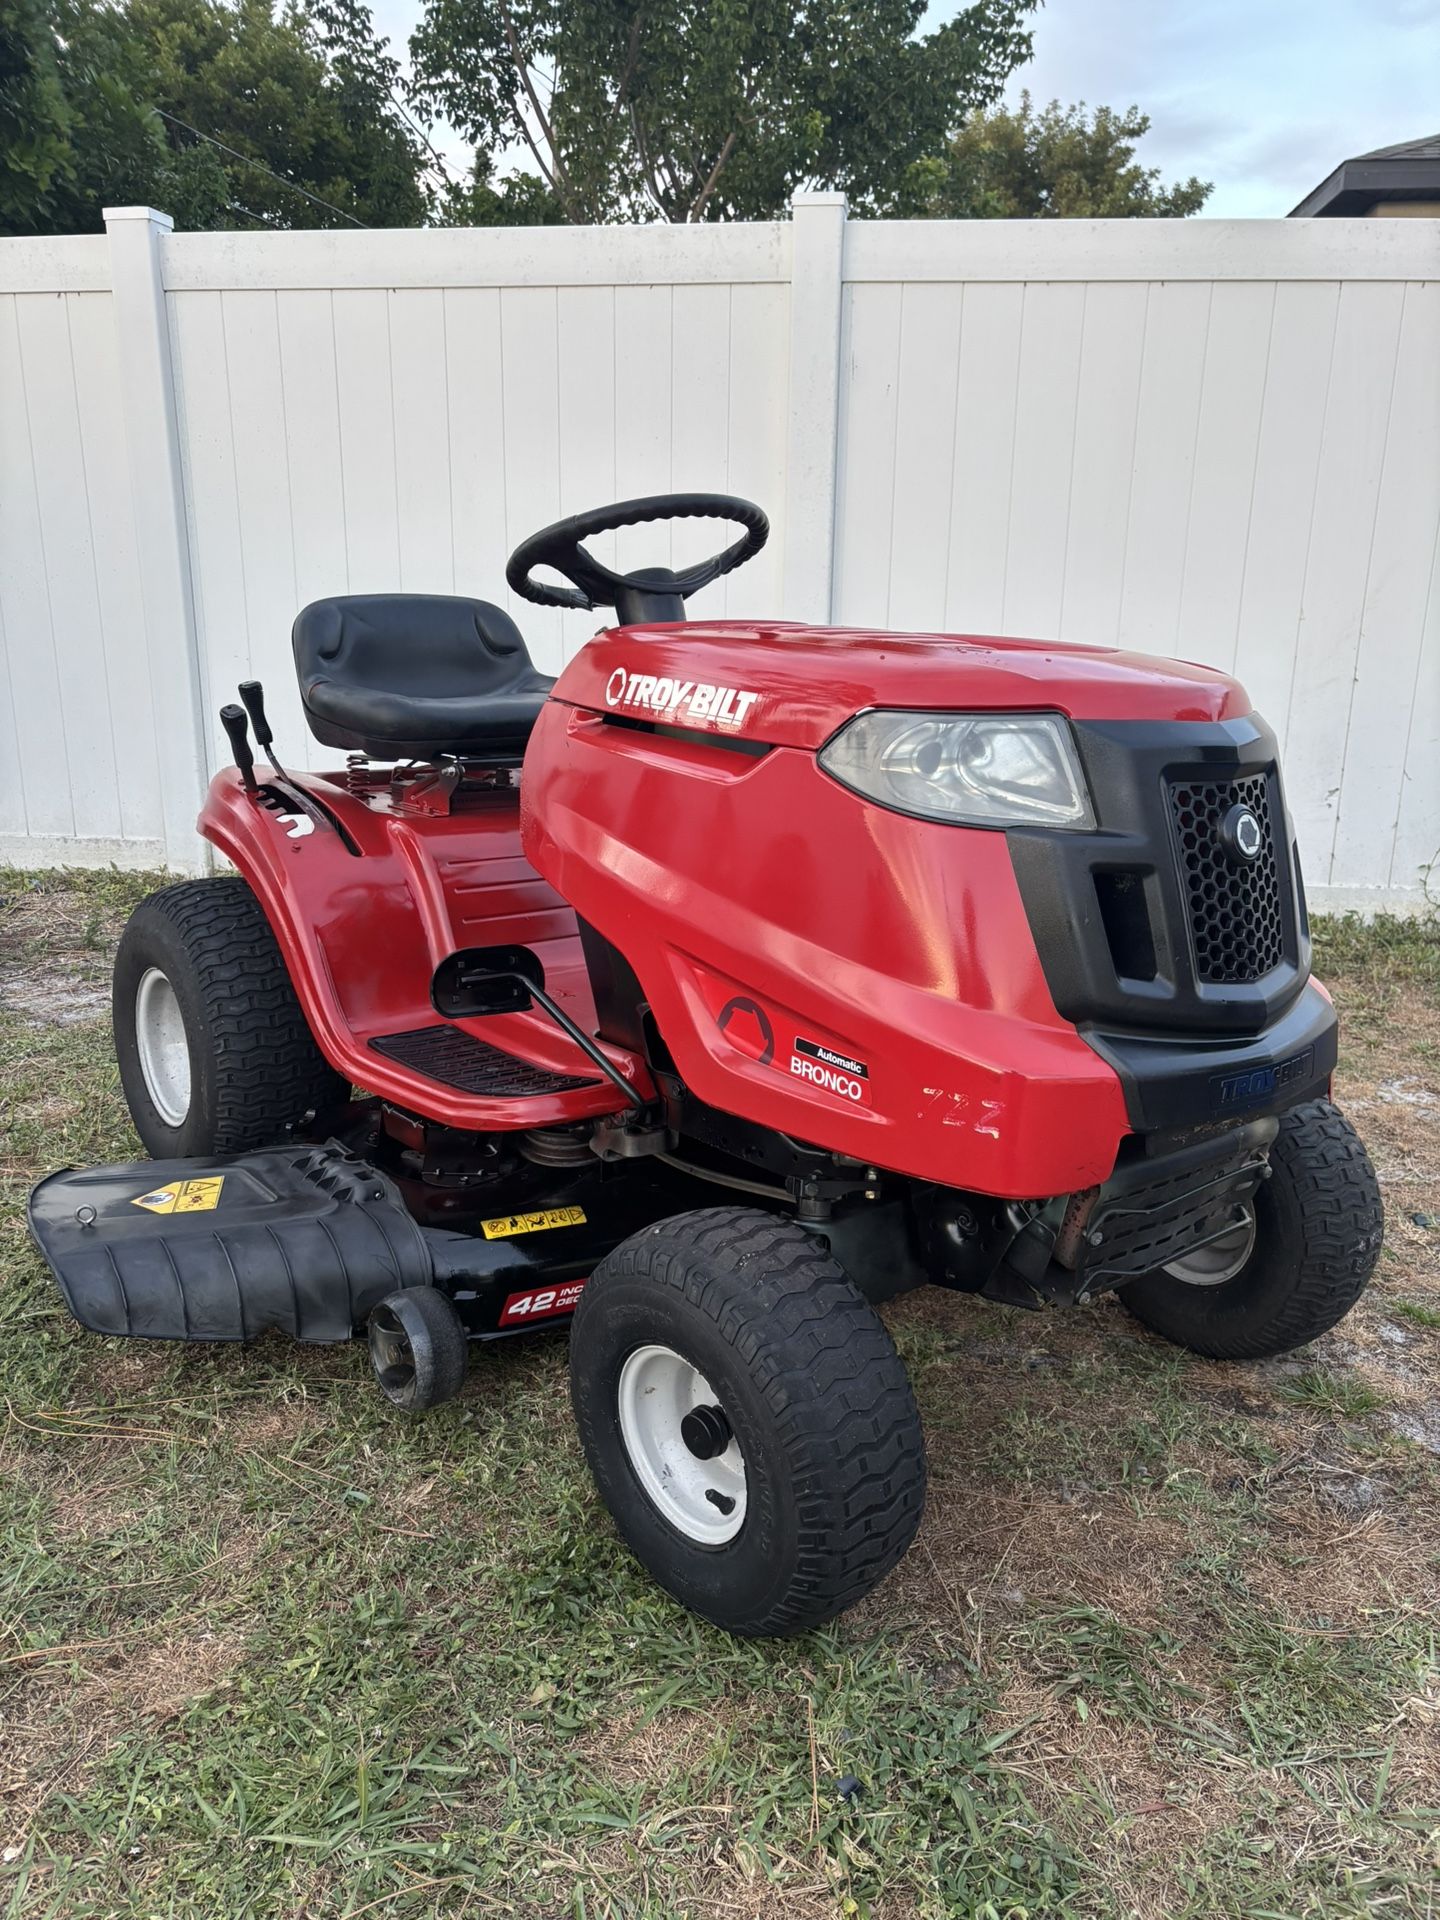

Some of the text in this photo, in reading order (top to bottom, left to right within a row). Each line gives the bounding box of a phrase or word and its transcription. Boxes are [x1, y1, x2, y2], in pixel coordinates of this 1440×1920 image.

[626, 673, 758, 726] TROY-BILT
[817, 1047, 862, 1074] Automatic
[790, 1055, 862, 1101] BRONCO
[508, 1284, 584, 1315] 42 INC
[555, 1295, 580, 1307] DEC
